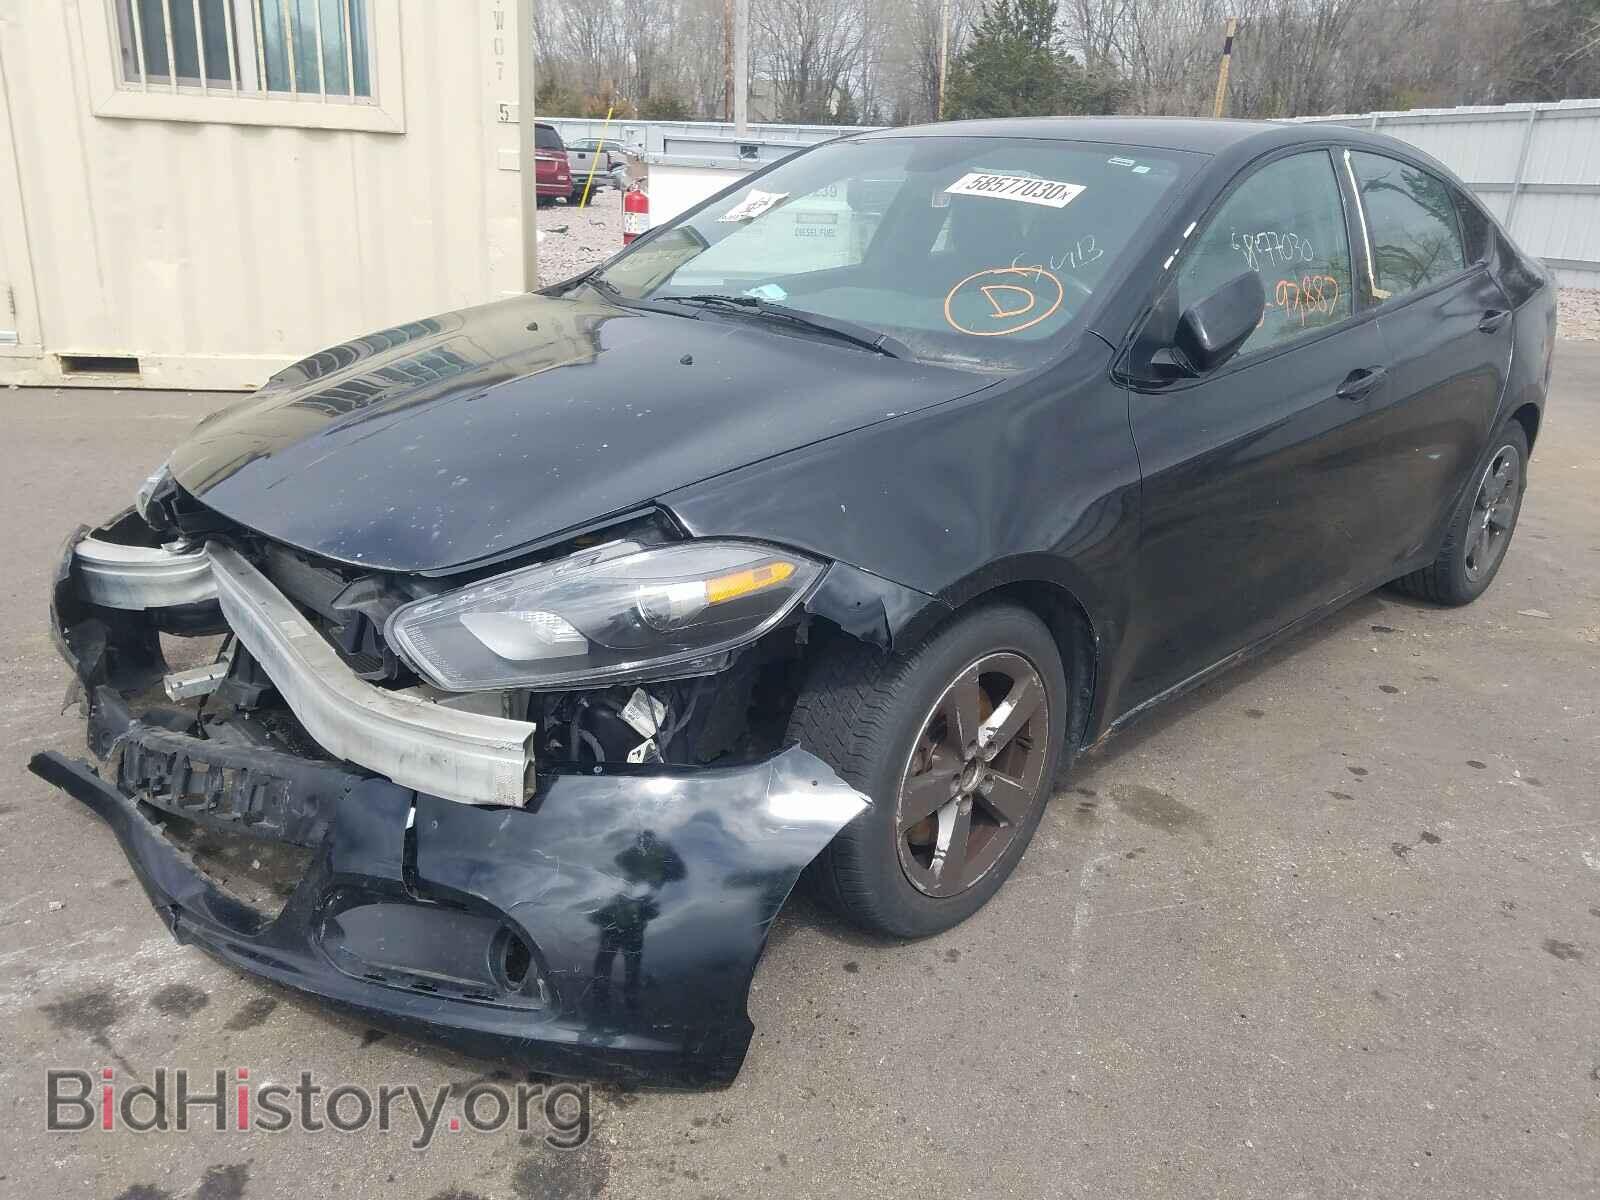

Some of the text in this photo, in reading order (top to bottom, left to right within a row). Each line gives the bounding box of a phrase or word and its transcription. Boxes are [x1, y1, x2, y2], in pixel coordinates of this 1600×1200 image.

[795, 226, 838, 239] DIESEL FUEL
[981, 285, 1035, 317] D
